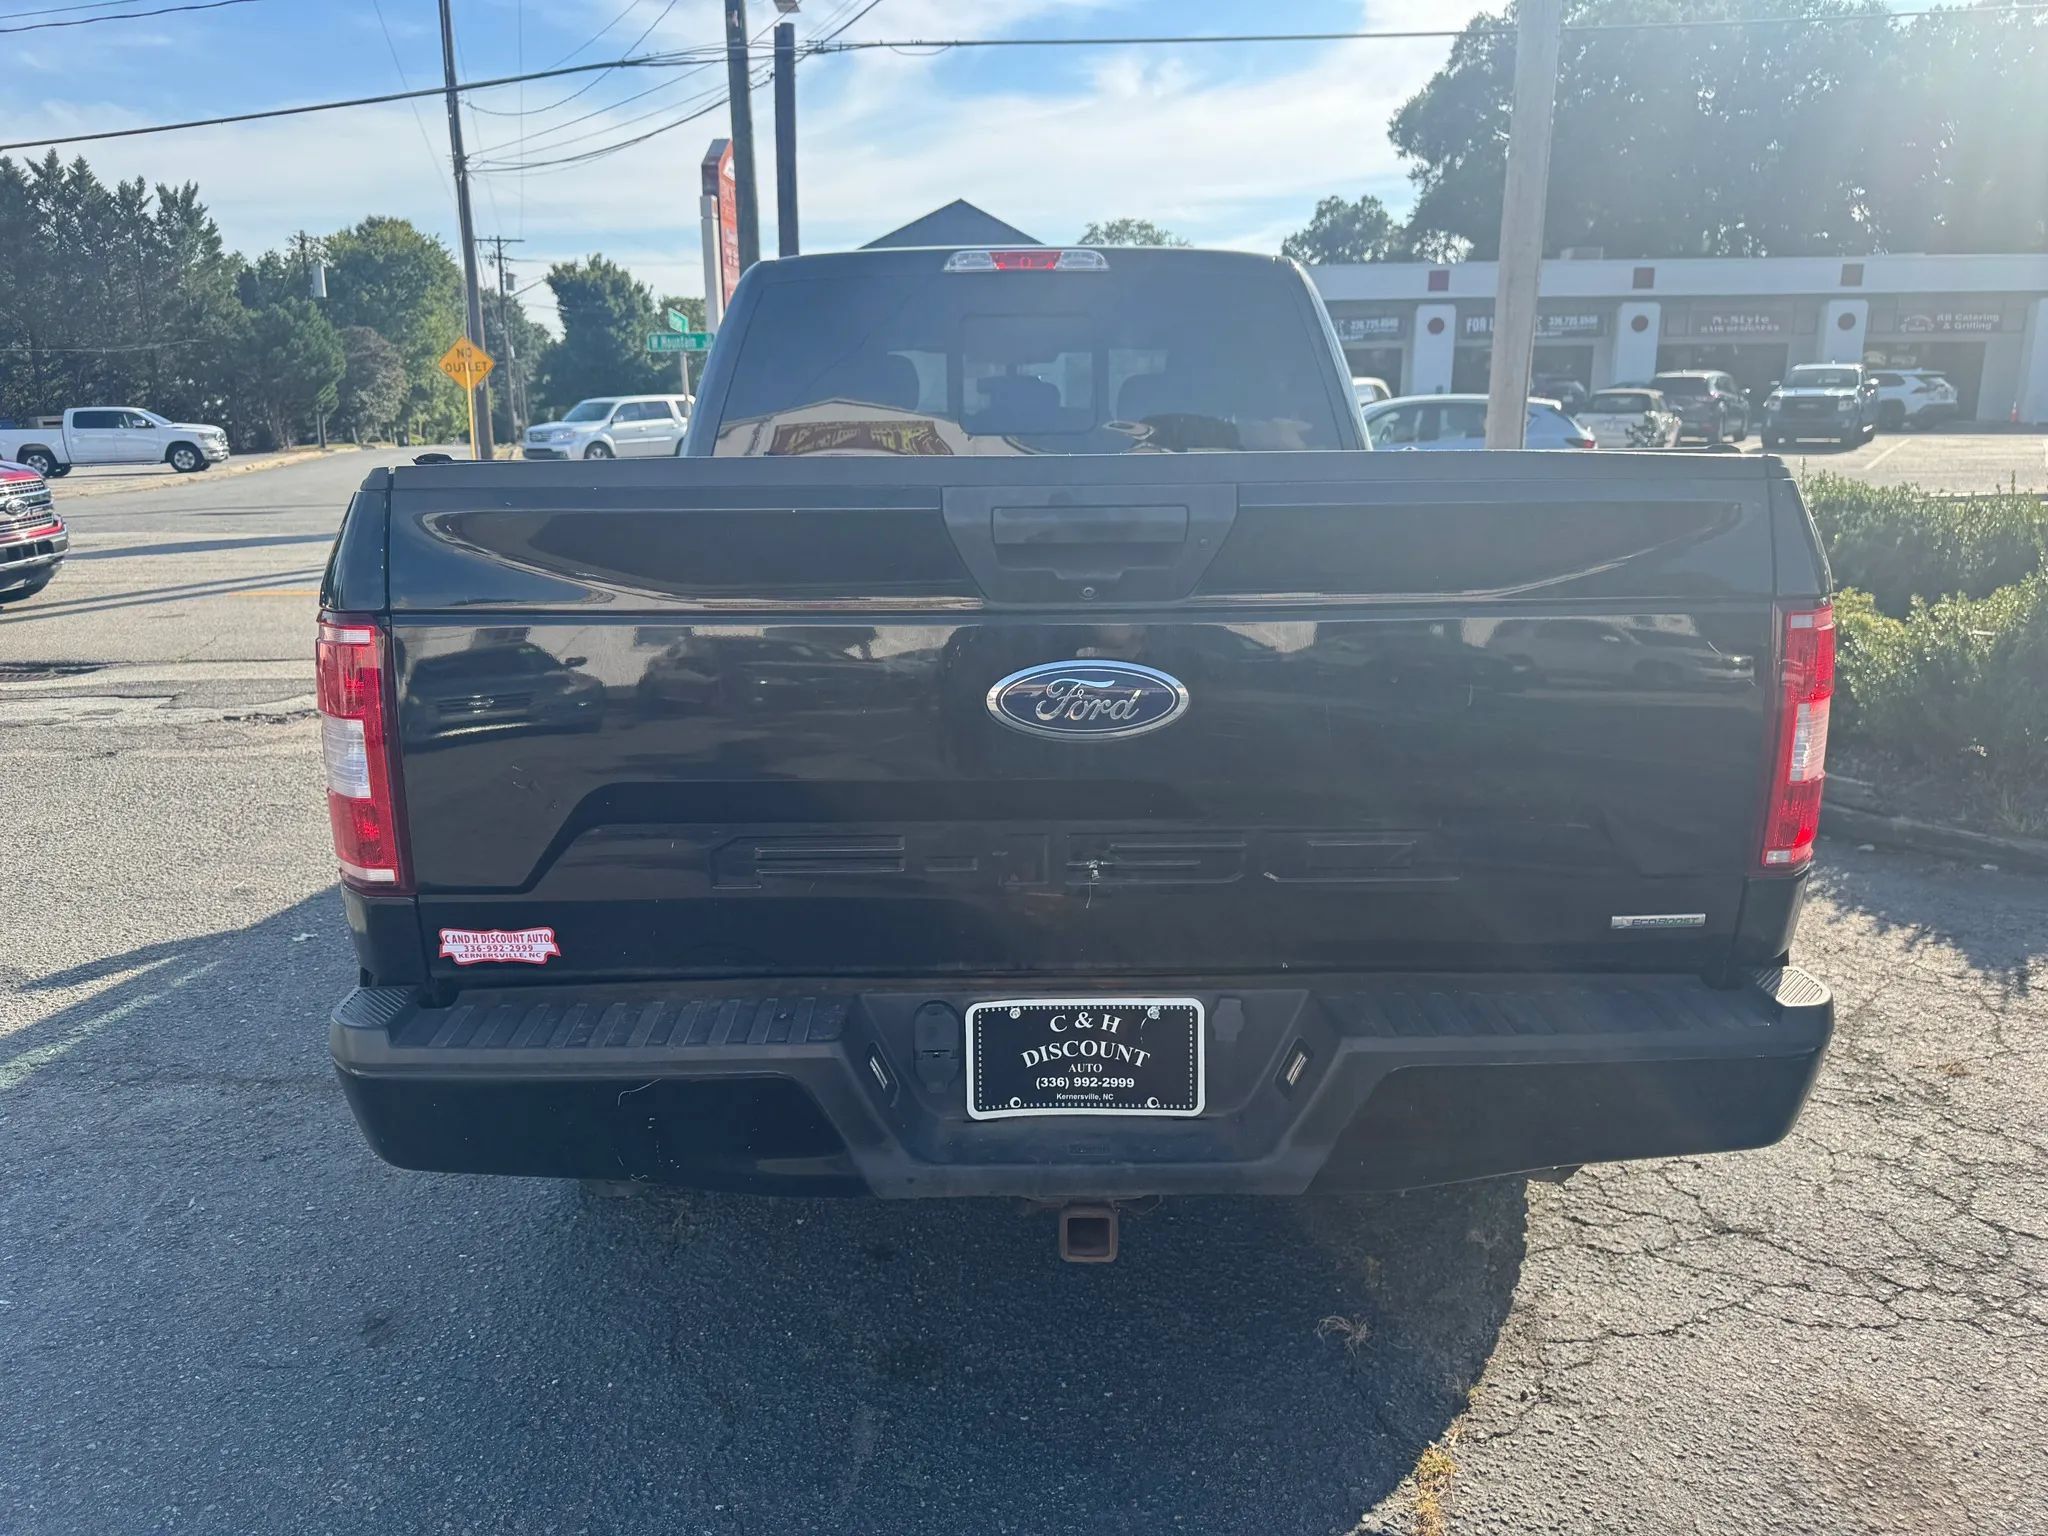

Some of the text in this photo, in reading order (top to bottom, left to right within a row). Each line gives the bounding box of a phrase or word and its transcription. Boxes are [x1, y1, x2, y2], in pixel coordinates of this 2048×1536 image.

[1466, 317, 1487, 333] FOR
[455, 347, 473, 359] NO
[445, 361, 488, 373] OUTLET
[1035, 678, 1142, 721] Ford
[445, 933, 550, 944] C AND H DISCOUNT AUTO
[464, 944, 534, 952] 336-992-2999
[1049, 1011, 1123, 1034] C & H
[1020, 1039, 1151, 1068] DISCOUNT
[1068, 1063, 1103, 1073] AUTO
[1035, 1077, 1135, 1090] (336) 992-2999
[1056, 1092, 1114, 1101] Kernersville, NC
